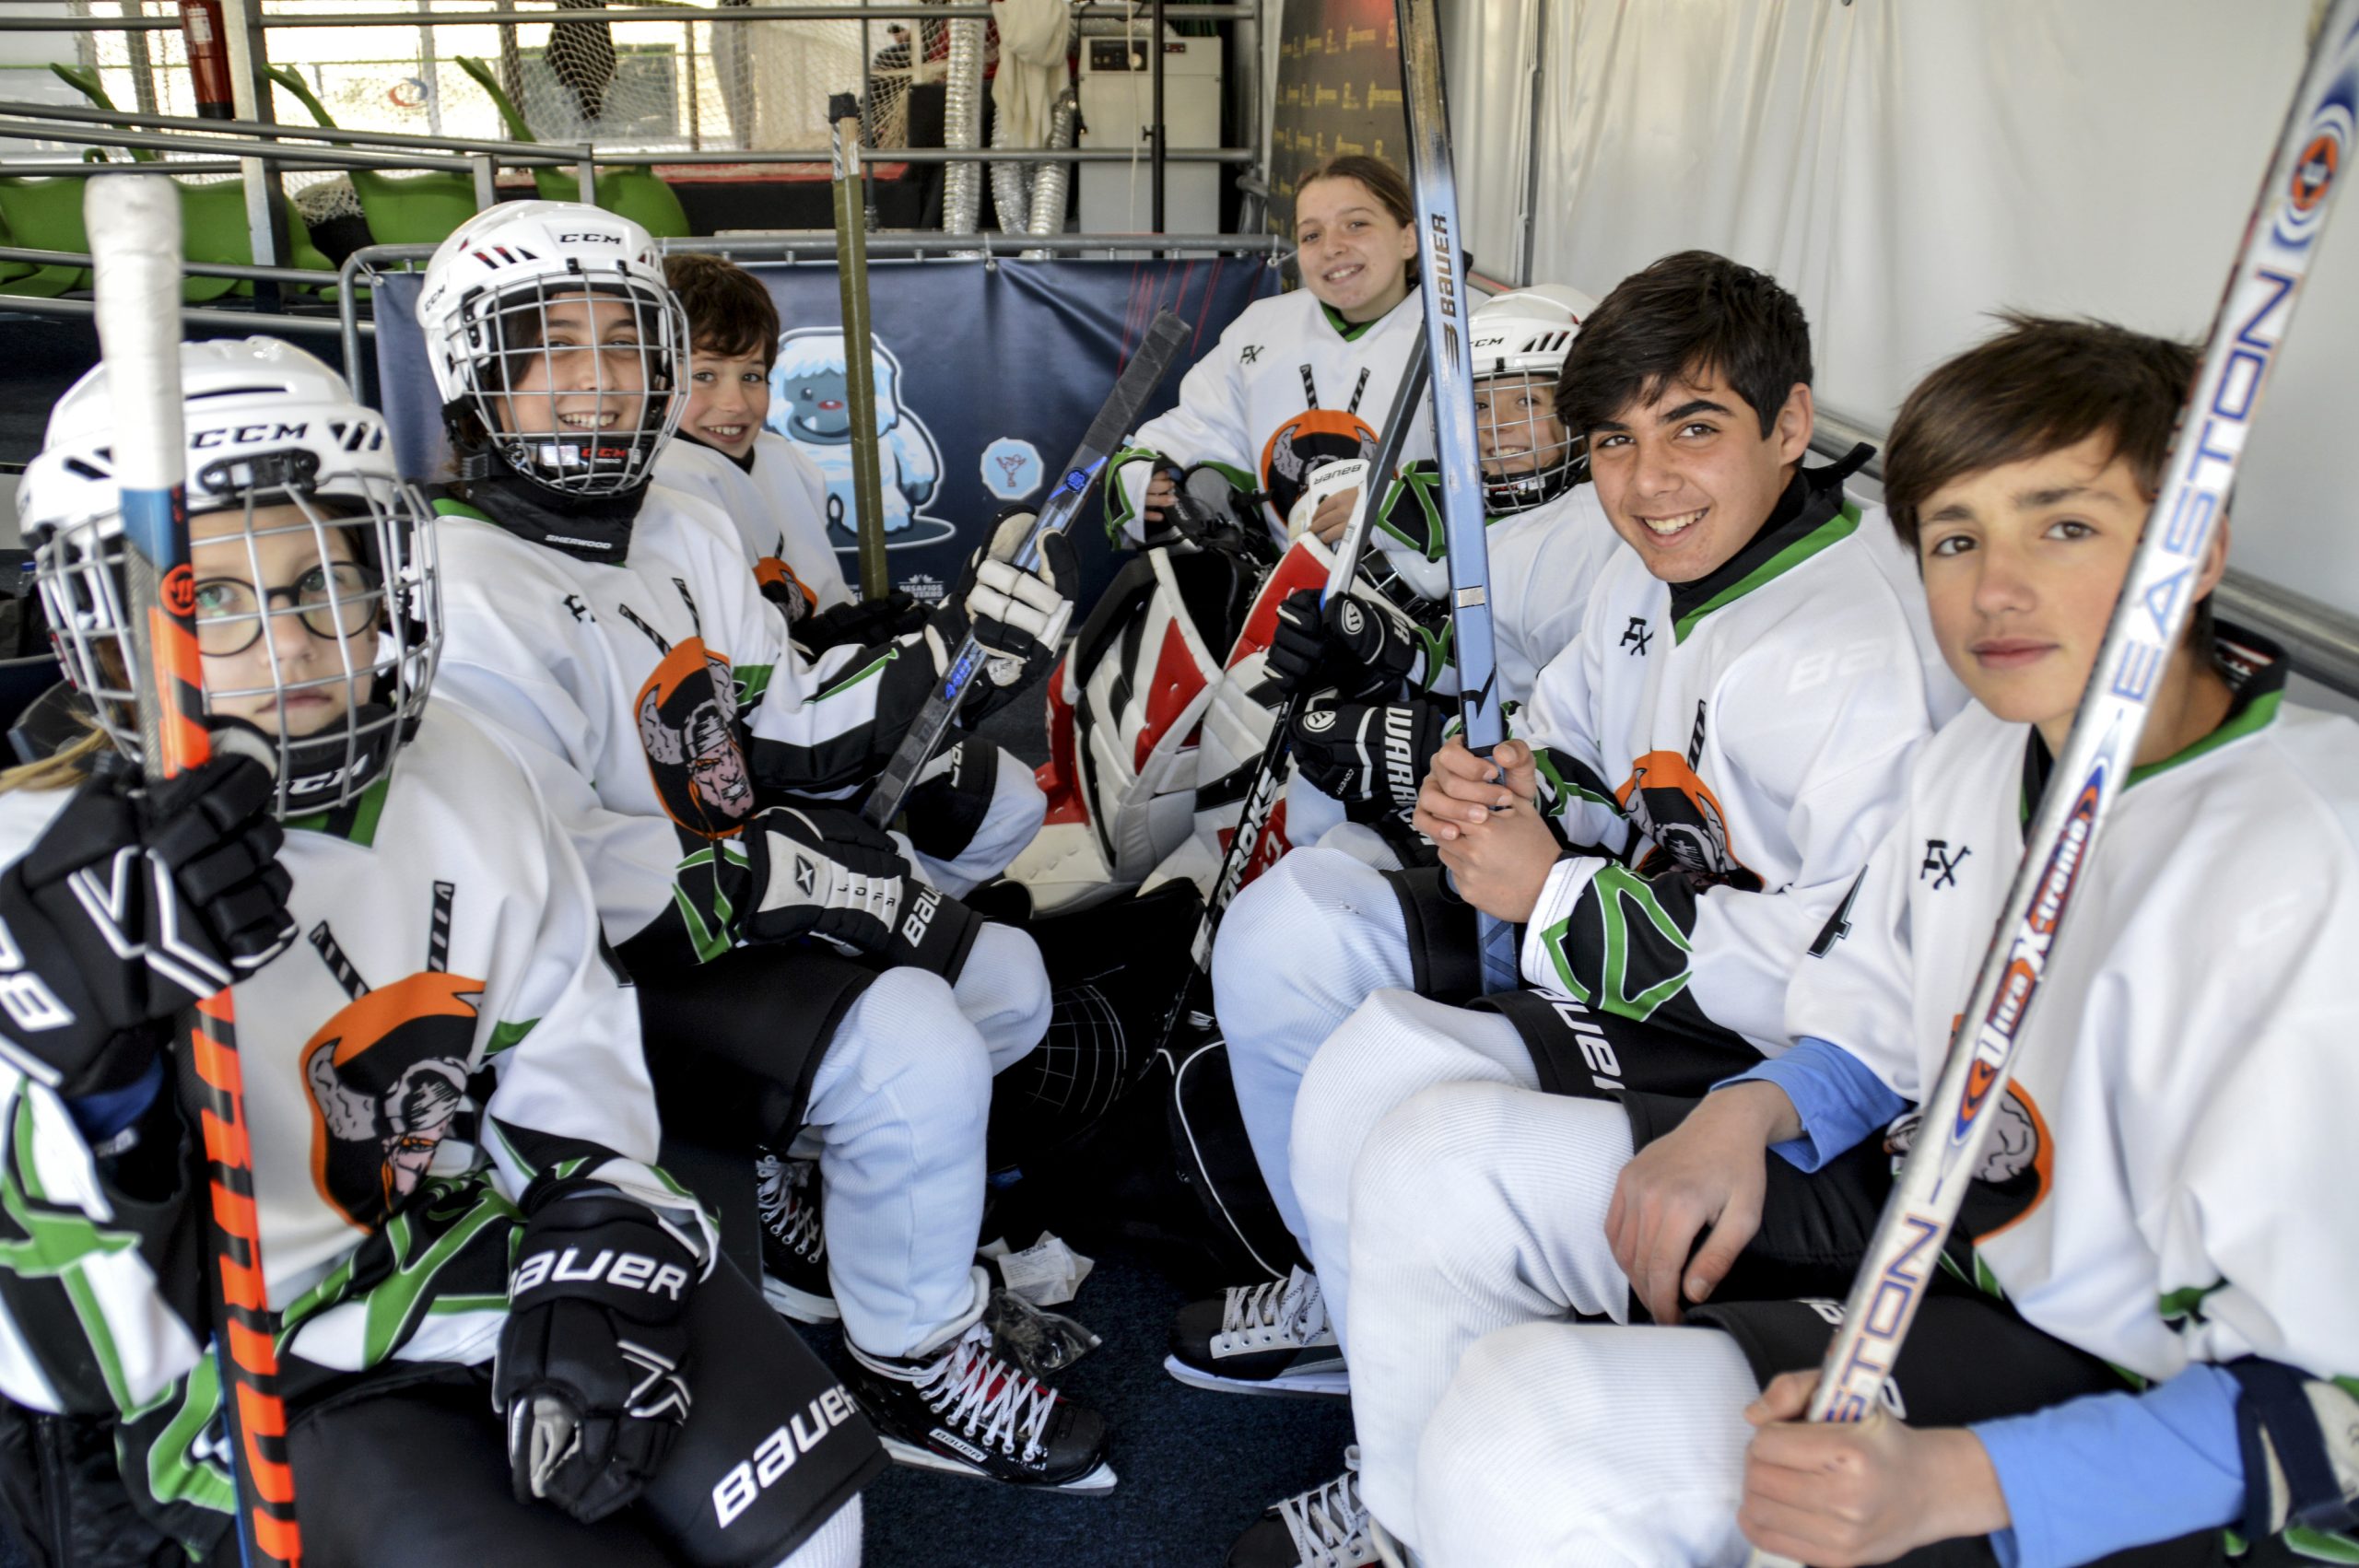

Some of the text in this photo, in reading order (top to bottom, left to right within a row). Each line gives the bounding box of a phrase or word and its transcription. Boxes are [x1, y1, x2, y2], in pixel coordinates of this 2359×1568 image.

[559, 233, 622, 245] CCM
[1431, 213, 1457, 318] BAUER
[424, 285, 446, 311] CCM
[1469, 337, 1505, 347] CM
[188, 422, 310, 450] CCM
[1313, 463, 1363, 486] BAUER
[2111, 267, 2302, 703] EASTON
[545, 534, 613, 550] SHERWOOD
[272, 754, 369, 796] CM
[1336, 768, 1355, 795] COVERT
[901, 885, 944, 948] BAU
[509, 1247, 687, 1305] AUER
[1825, 1213, 1945, 1423] STON
